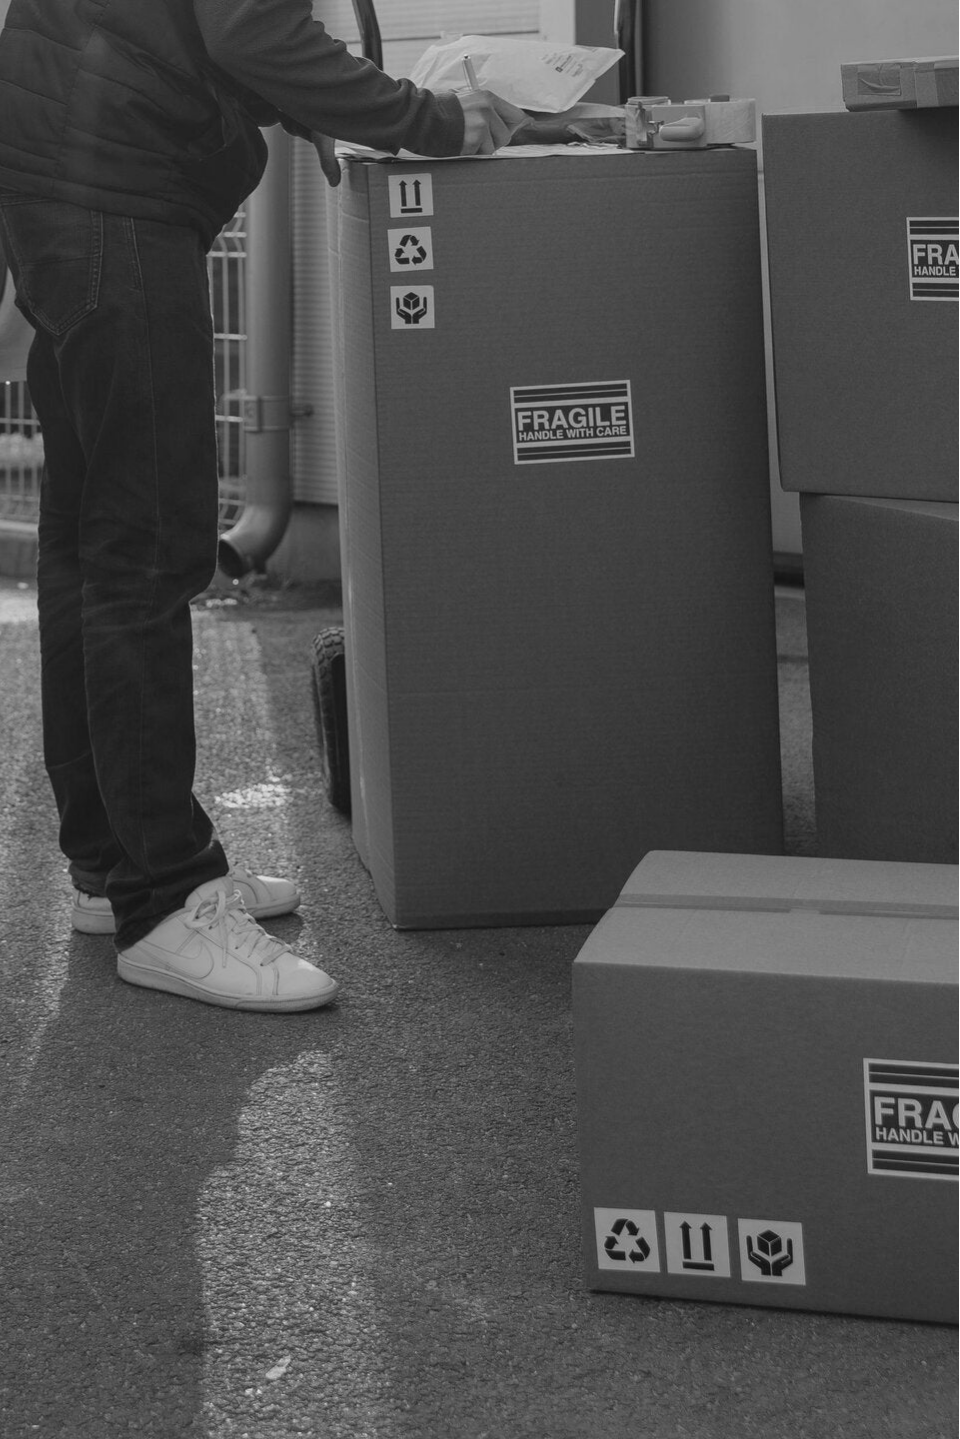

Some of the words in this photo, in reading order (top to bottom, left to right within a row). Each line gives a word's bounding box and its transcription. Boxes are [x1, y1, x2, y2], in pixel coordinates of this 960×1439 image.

[914, 266, 956, 276] HANDLE
[517, 405, 627, 431] FRAGILE
[519, 430, 564, 441] HANDLE
[566, 428, 594, 438] WITH
[596, 426, 627, 436] CARE
[874, 1096, 960, 1131] FRA
[876, 1127, 944, 1145] HANDLE
